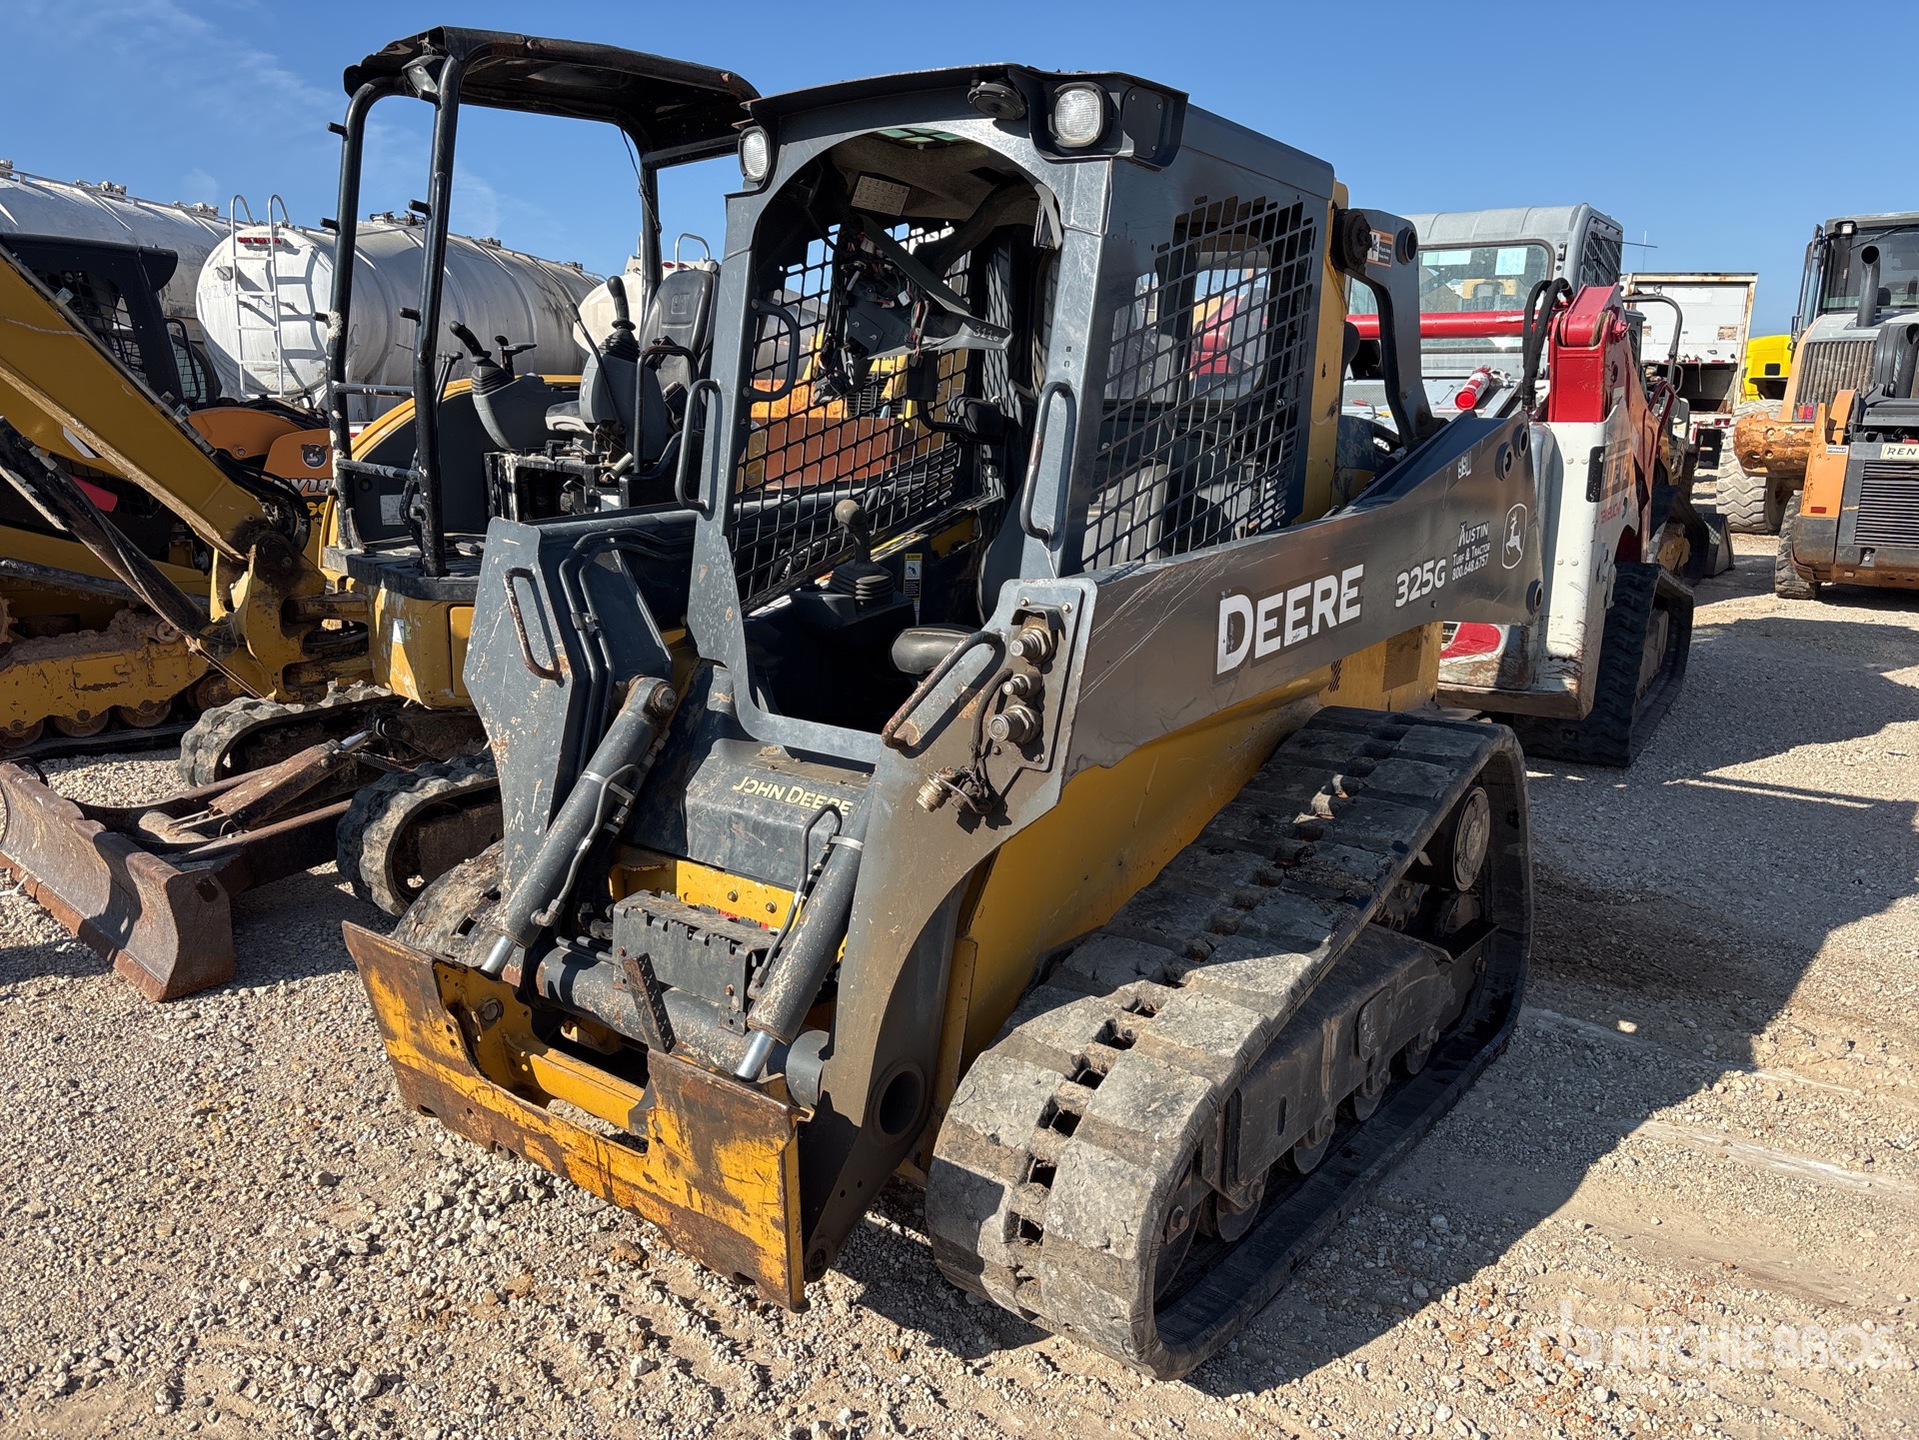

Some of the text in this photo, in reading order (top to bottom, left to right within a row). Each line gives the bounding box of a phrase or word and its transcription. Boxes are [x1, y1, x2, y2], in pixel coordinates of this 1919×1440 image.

[1458, 523, 1489, 548] AUSTIN
[1395, 559, 1446, 608] 325G
[1216, 563, 1364, 675] DEERE
[732, 776, 786, 801] JOHN
